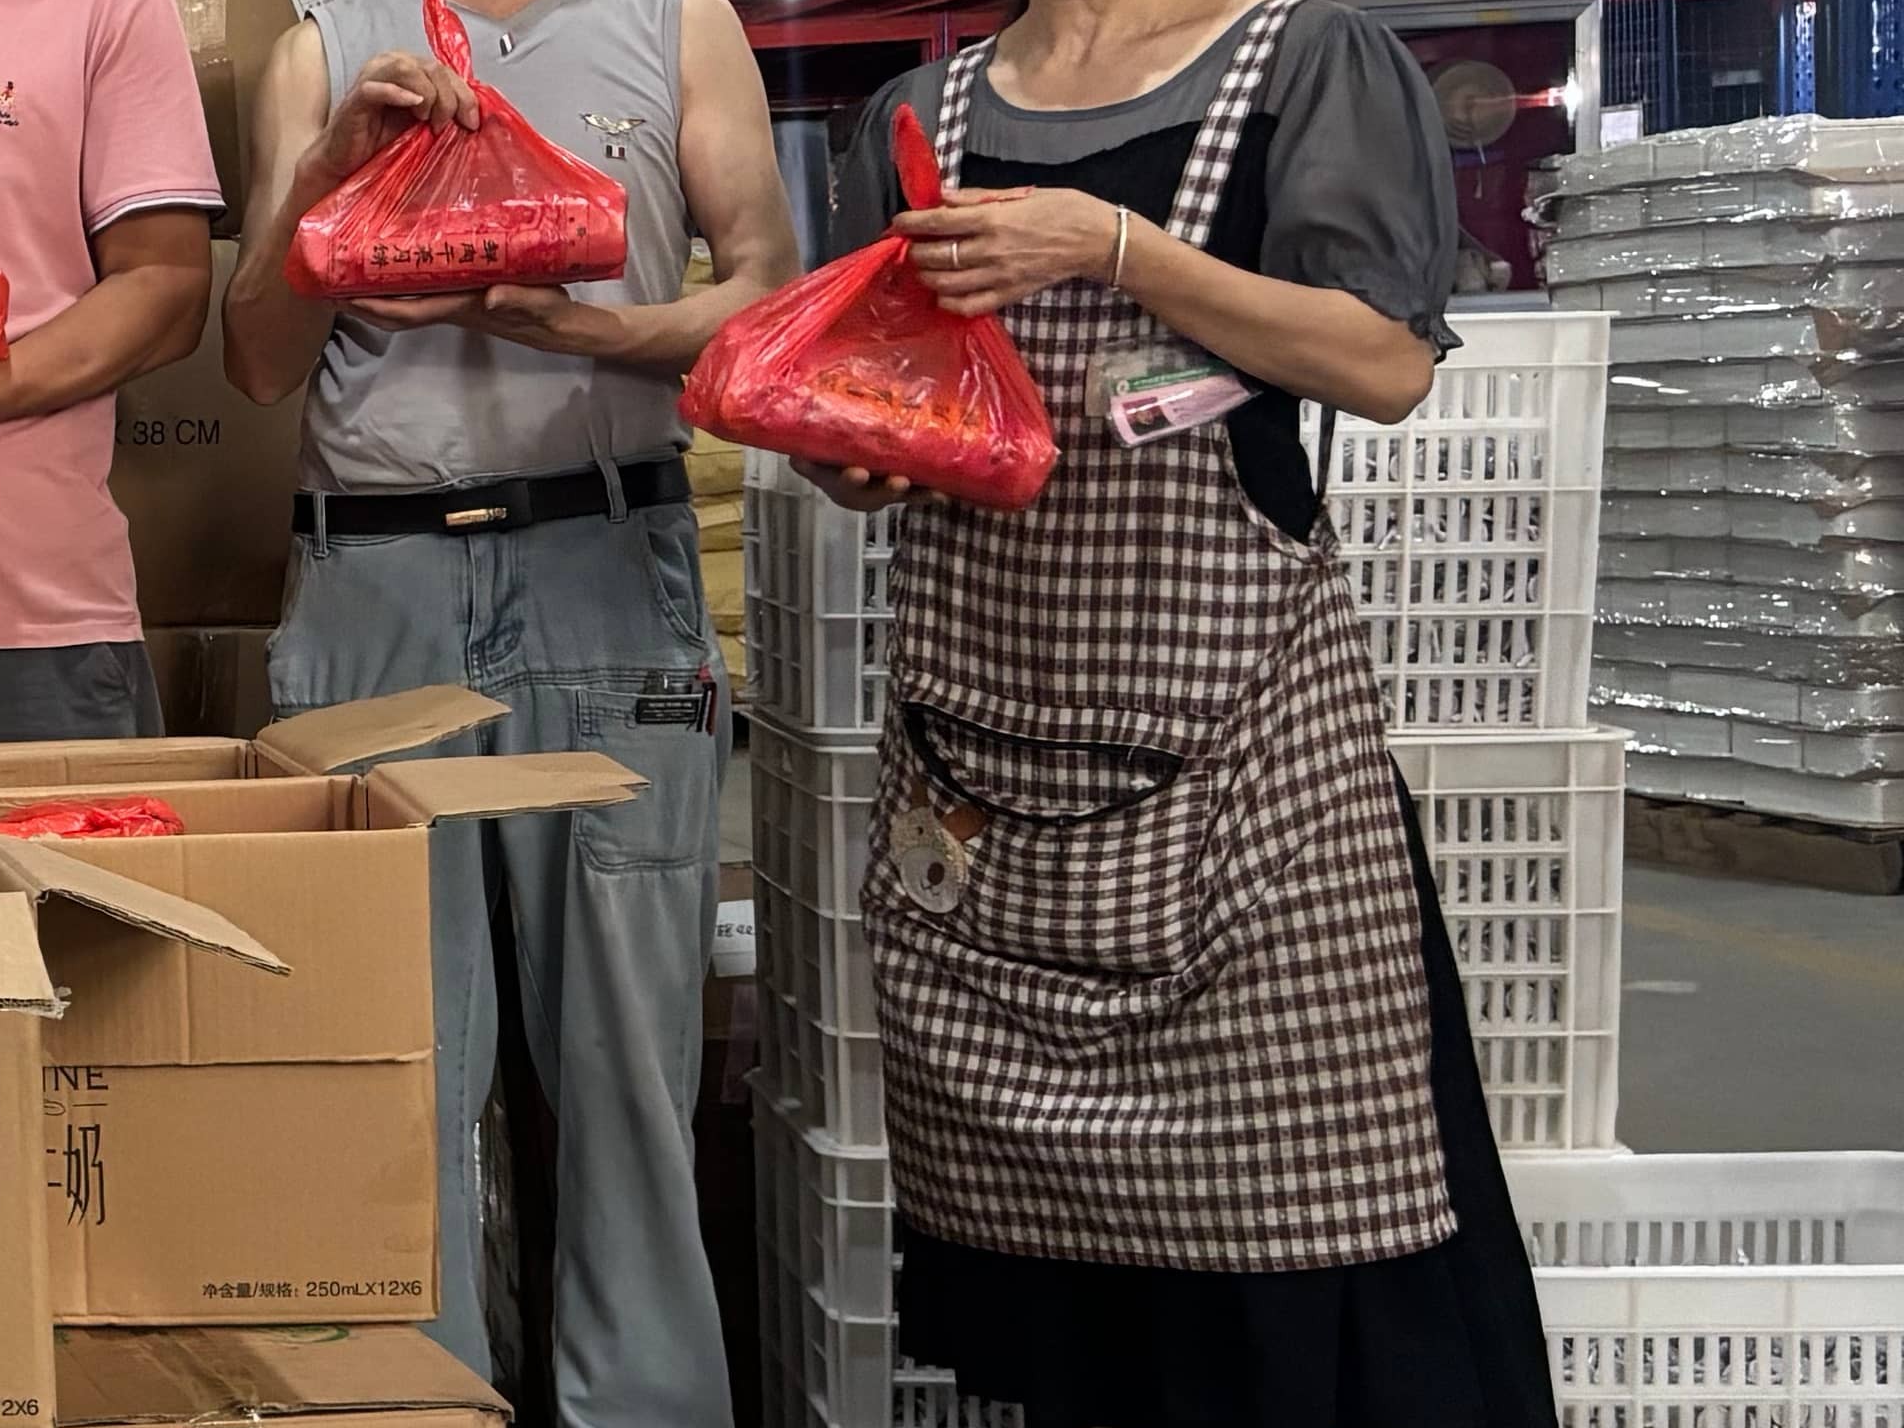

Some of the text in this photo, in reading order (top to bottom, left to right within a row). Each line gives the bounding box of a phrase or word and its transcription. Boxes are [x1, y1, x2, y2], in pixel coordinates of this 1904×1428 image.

[132, 419, 221, 445] 38 CM
[305, 1280, 423, 1298] 250mLX12X6
